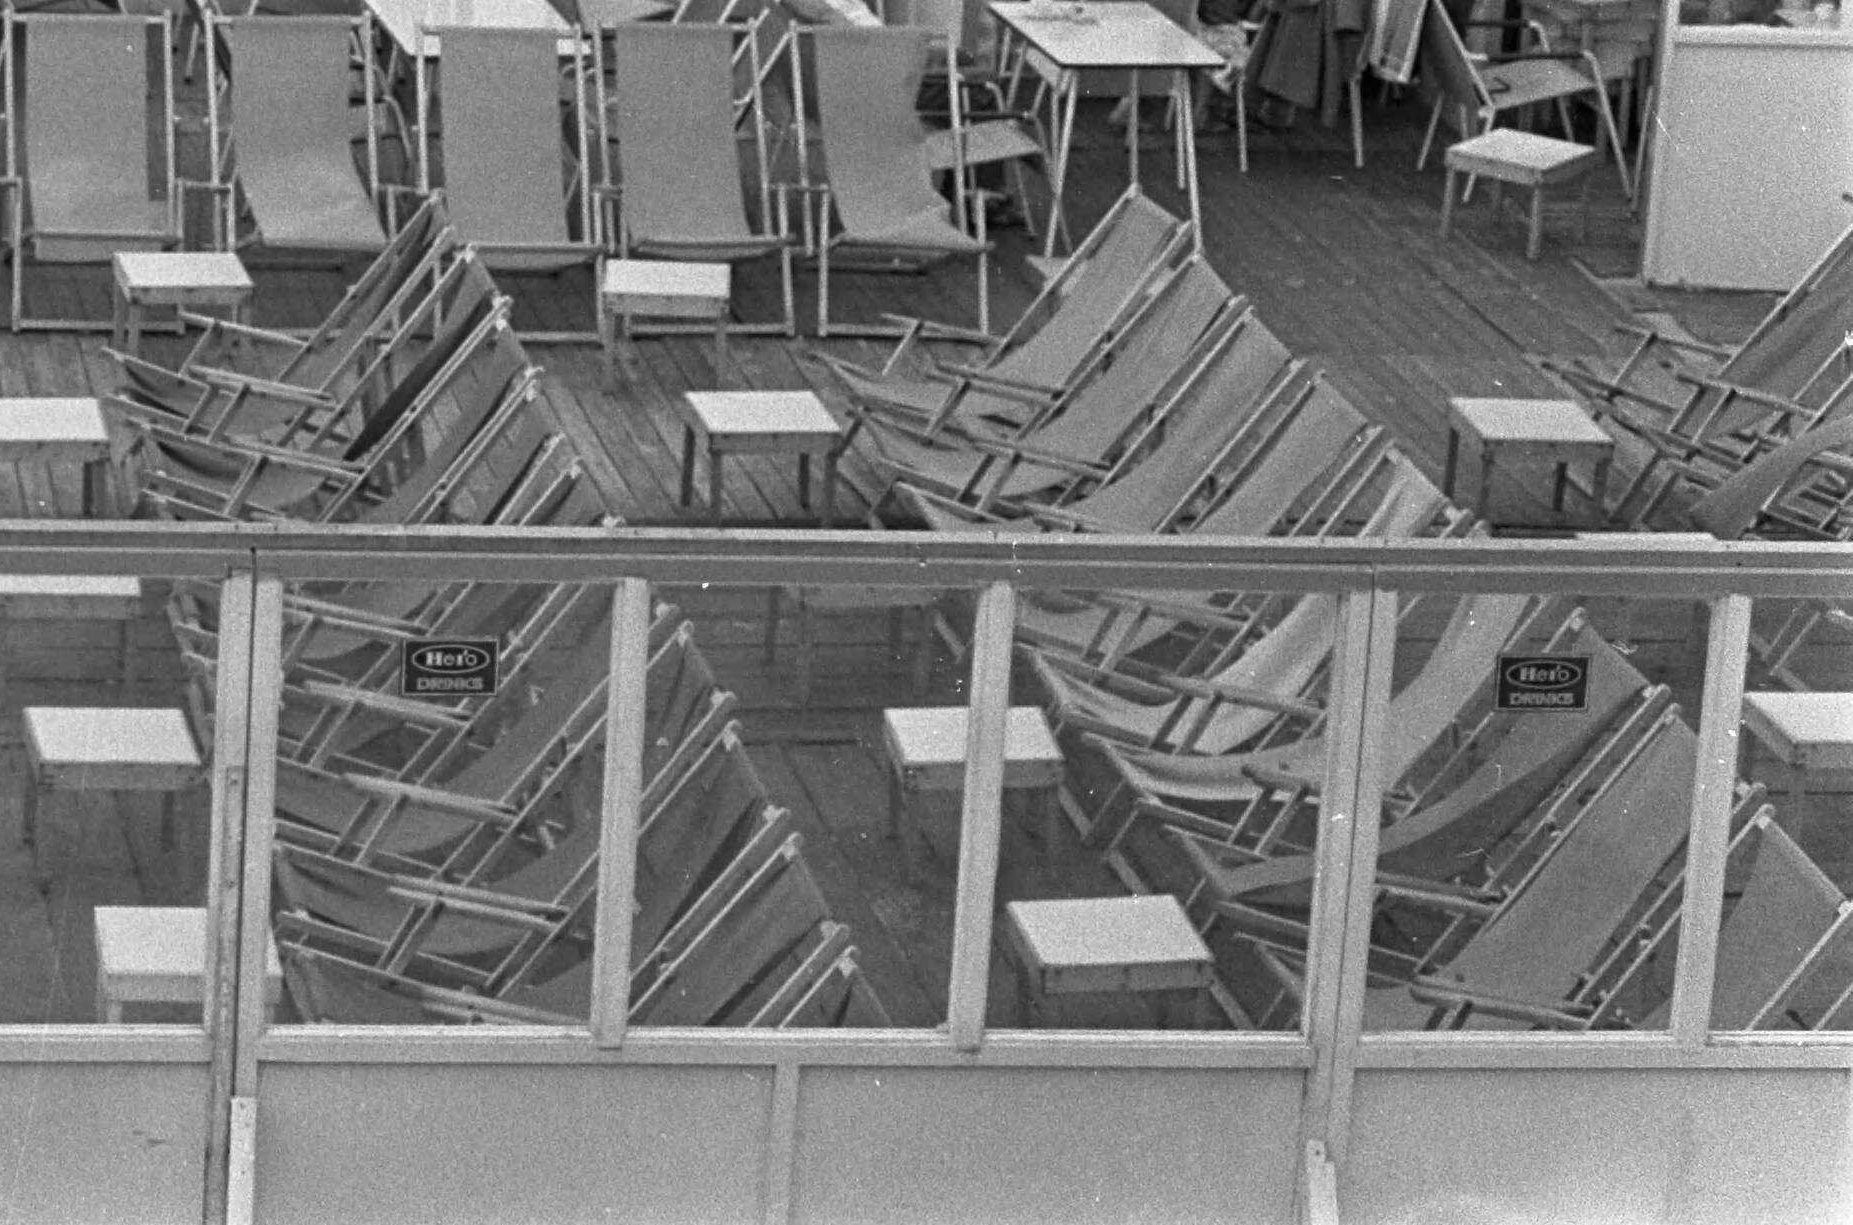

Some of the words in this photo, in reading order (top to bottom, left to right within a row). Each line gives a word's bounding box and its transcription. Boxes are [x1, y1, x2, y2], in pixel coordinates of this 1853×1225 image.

[425, 648, 478, 667] Hero
[1519, 663, 1571, 683] Hero
[416, 677, 484, 691] DRINKS
